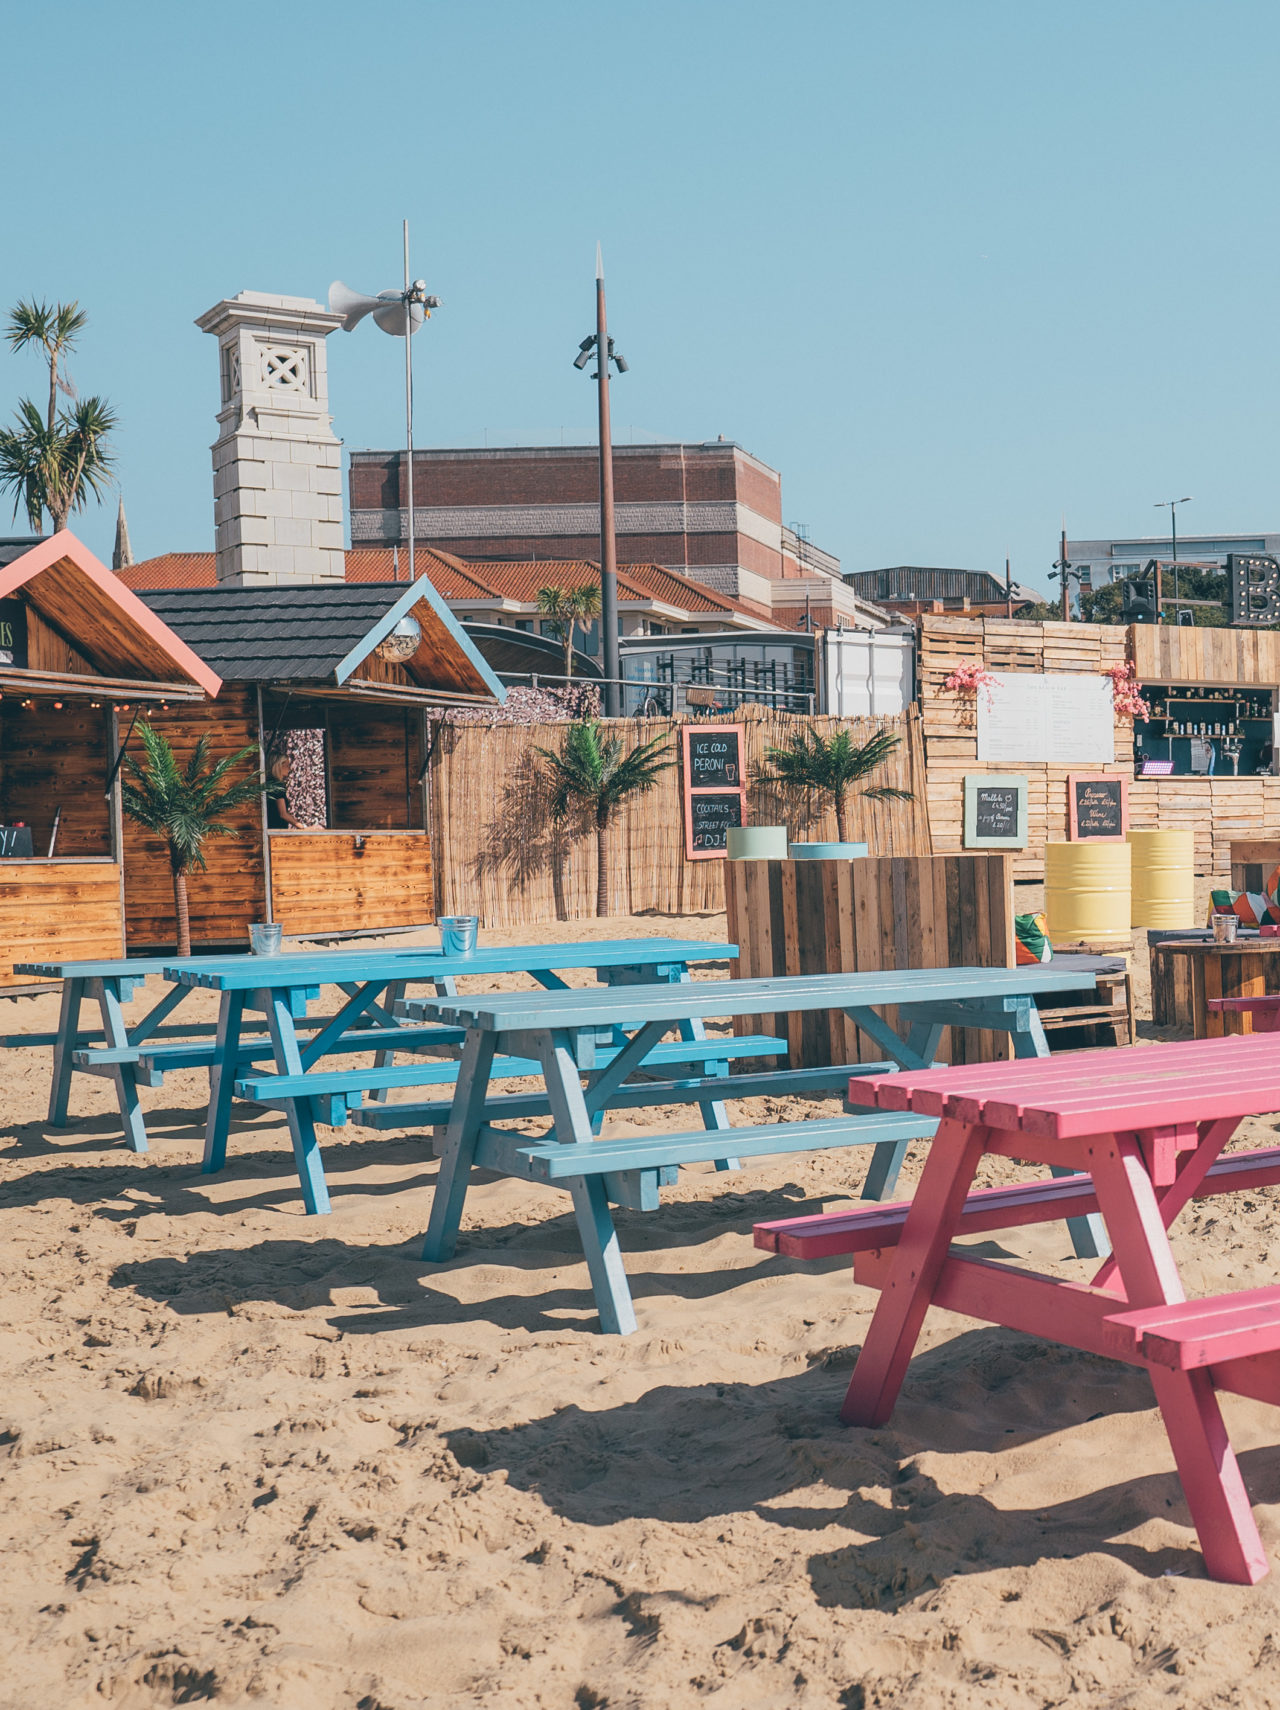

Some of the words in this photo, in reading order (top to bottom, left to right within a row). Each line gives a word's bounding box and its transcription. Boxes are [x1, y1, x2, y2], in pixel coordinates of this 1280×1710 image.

[696, 743, 709, 754] ICE
[710, 743, 728, 753] COLD
[694, 757, 725, 771] PERONI
[696, 803, 729, 814] COCKTAILS
[698, 821, 720, 830] STREET
